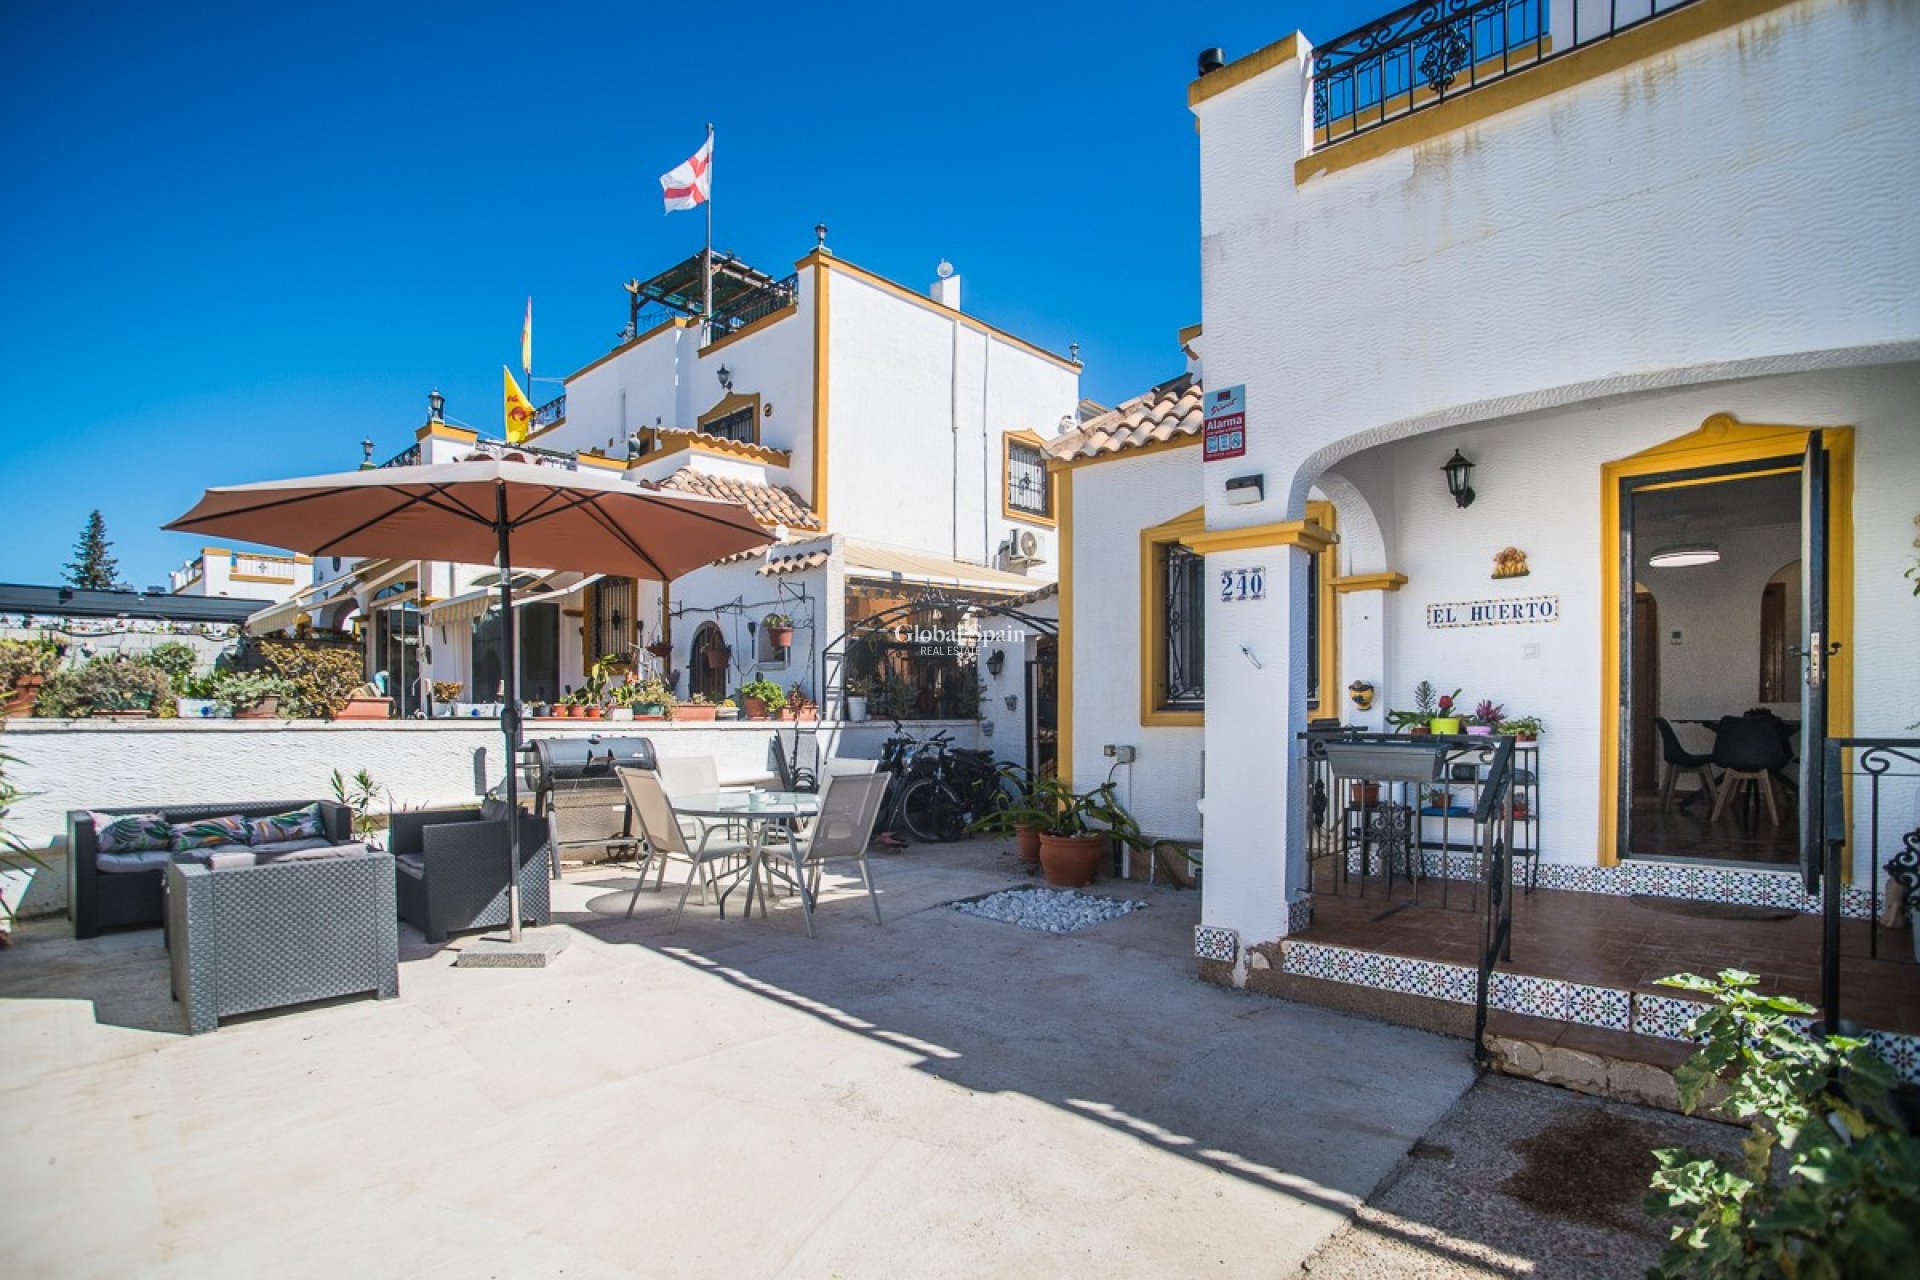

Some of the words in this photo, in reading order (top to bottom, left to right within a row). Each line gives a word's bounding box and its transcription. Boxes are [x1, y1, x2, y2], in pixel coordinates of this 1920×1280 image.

[1207, 416, 1242, 431] Alarma
[1221, 574, 1262, 596] 240
[1433, 608, 1456, 624] EL
[1470, 601, 1553, 622] HUERTO
